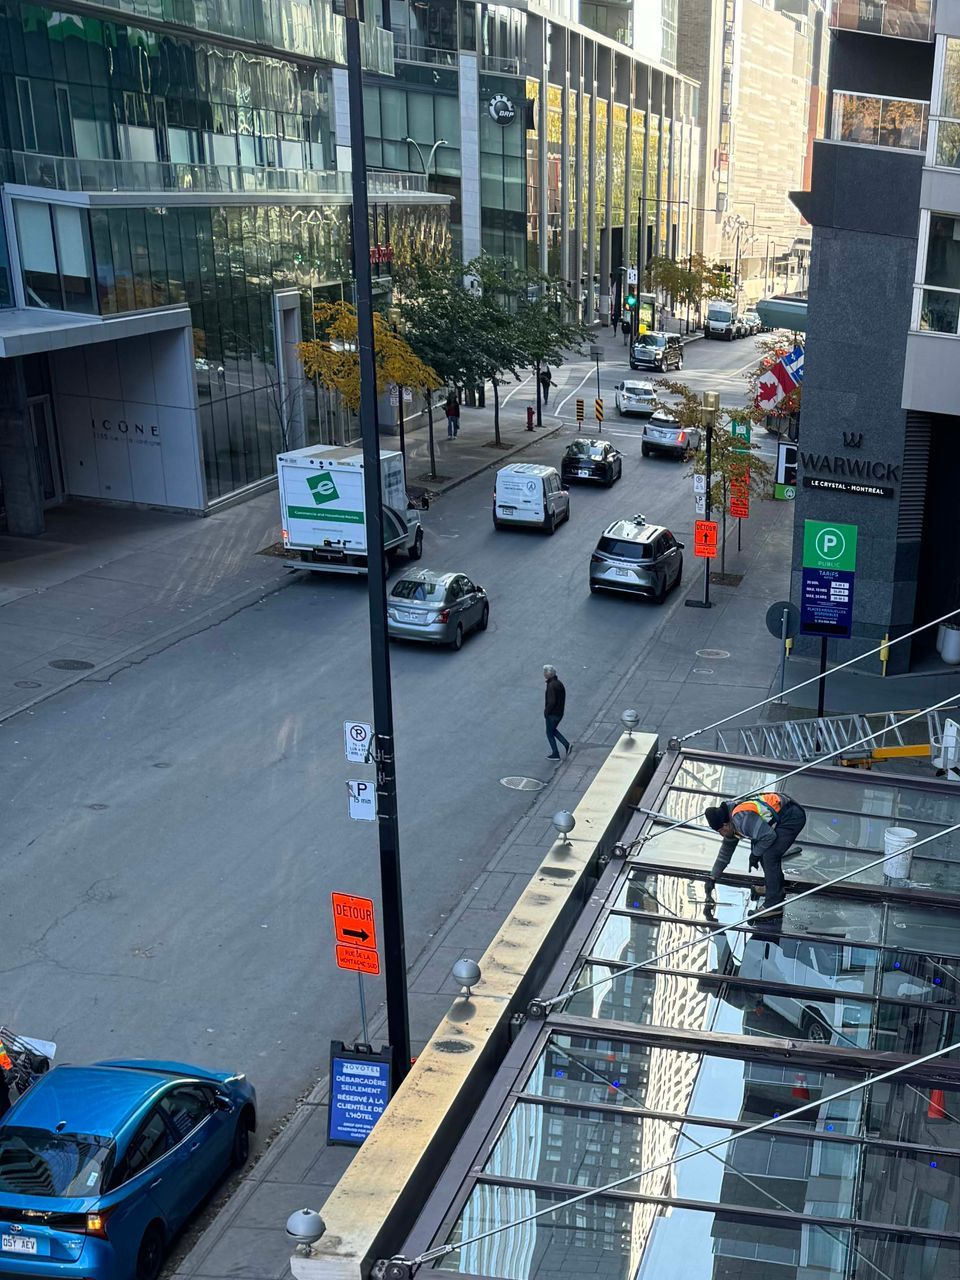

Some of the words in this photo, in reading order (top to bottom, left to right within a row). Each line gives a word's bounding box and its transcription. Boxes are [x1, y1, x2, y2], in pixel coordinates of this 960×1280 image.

[800, 452, 900, 481] WARWICK
[820, 481, 846, 490] CRYSTAL
[851, 484, 884, 495] MONTRÉAL
[823, 534, 837, 553] P
[357, 782, 367, 796] P
[336, 903, 372, 921] DÉTOUR
[340, 957, 366, 967] MONTAGNE
[343, 1064, 380, 1073] NOVOTEL
[336, 1075, 387, 1087] DÉBARCADÈRE
[341, 1084, 381, 1094] SEULEMENT
[337, 1094, 368, 1103] RÉSERVÉ
[336, 1102, 372, 1112] CLIENTÈLE
[345, 1112, 373, 1120] L'HÔTEL
[21, 1240, 35, 1250] AEV
